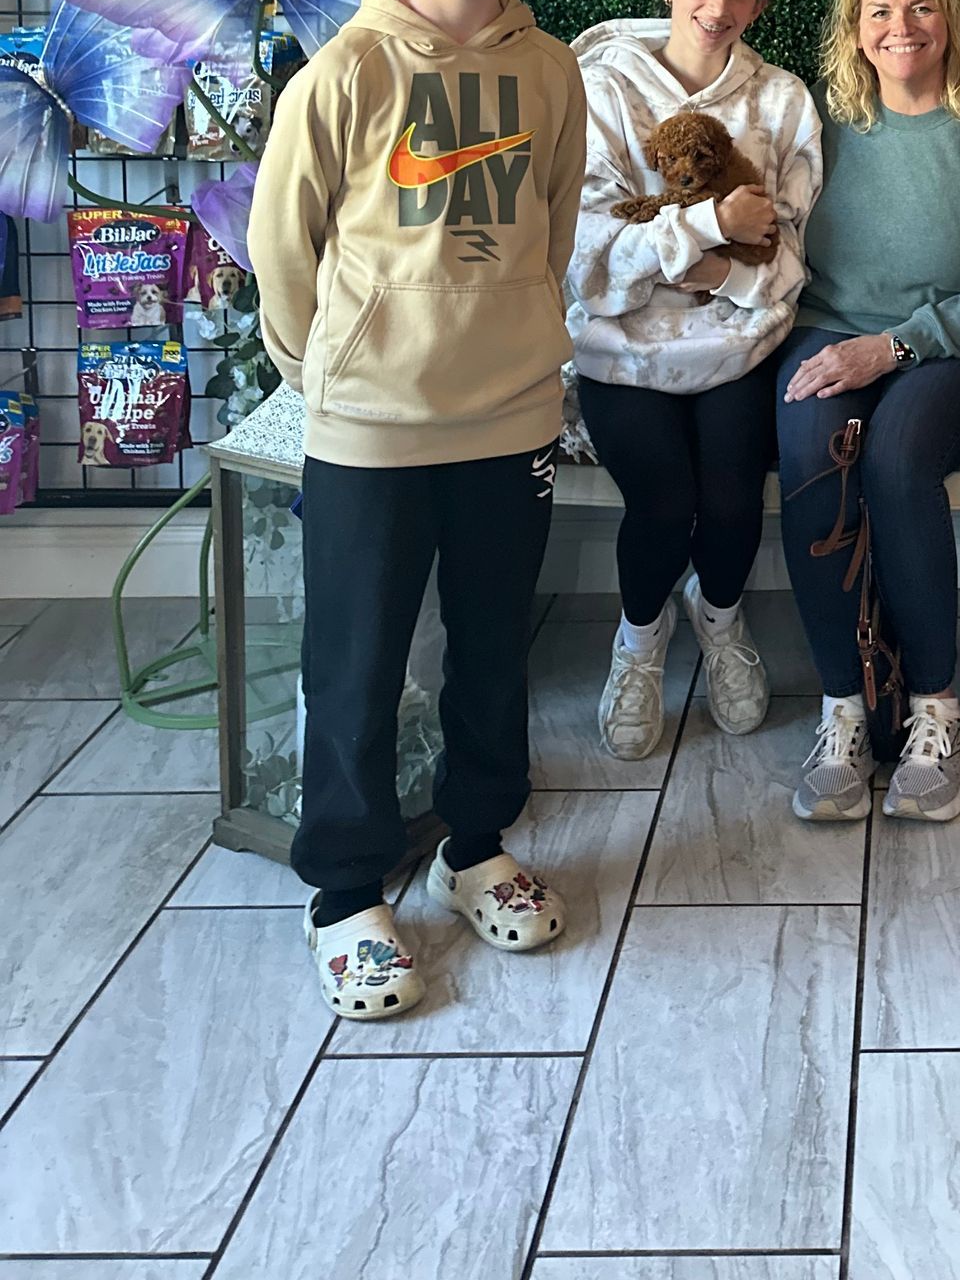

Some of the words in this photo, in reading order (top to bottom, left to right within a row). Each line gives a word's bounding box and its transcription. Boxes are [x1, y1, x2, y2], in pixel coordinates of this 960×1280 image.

[402, 72, 532, 152] ALL
[72, 209, 123, 221] SUPER
[398, 154, 532, 227] DAY
